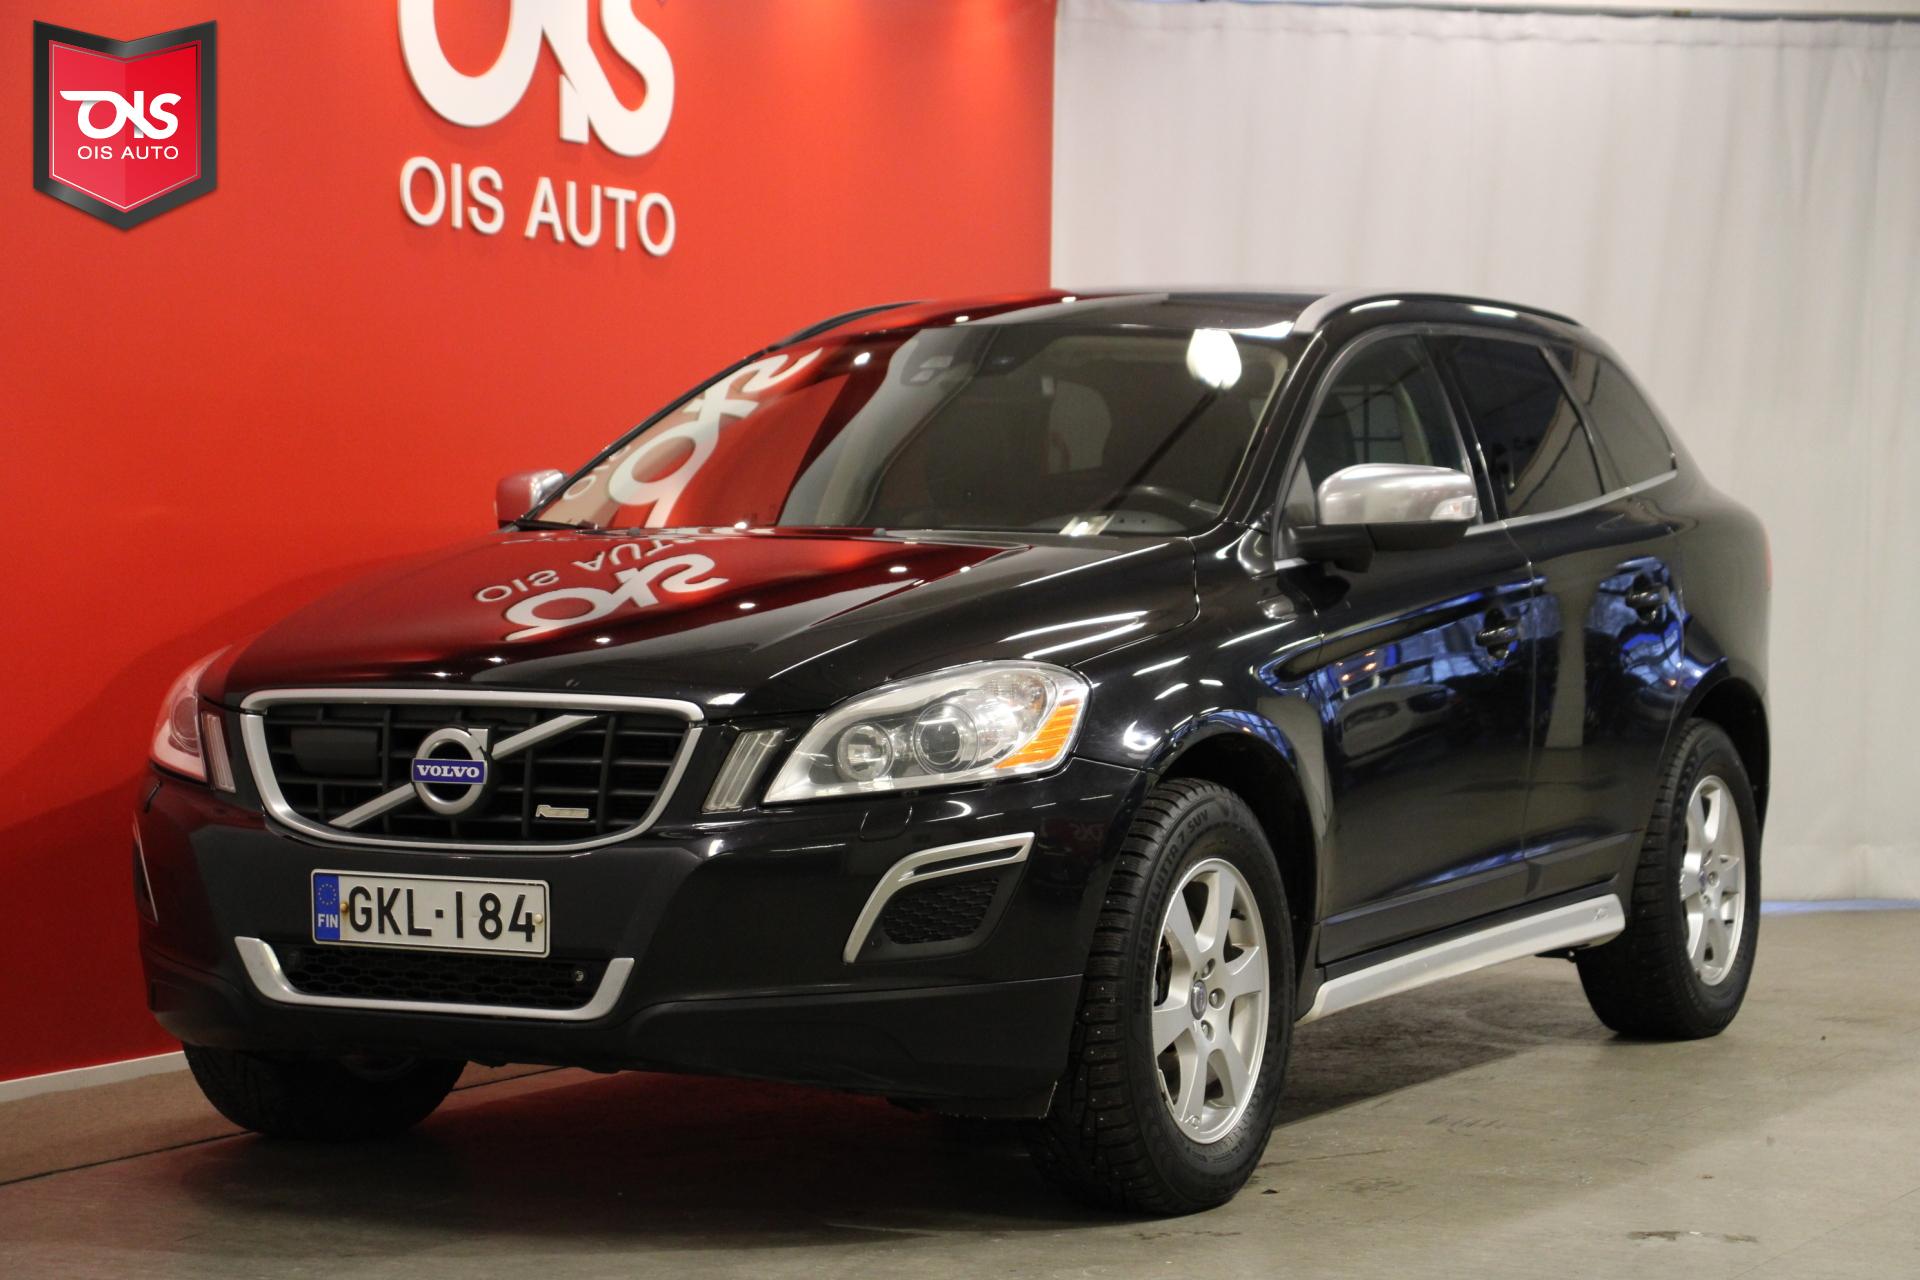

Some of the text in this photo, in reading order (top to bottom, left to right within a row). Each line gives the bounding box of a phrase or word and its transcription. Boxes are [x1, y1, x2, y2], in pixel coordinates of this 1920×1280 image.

[399, 156, 676, 257] OIS AUTO
[416, 764, 480, 778] VOLVO
[317, 913, 339, 929] FIN
